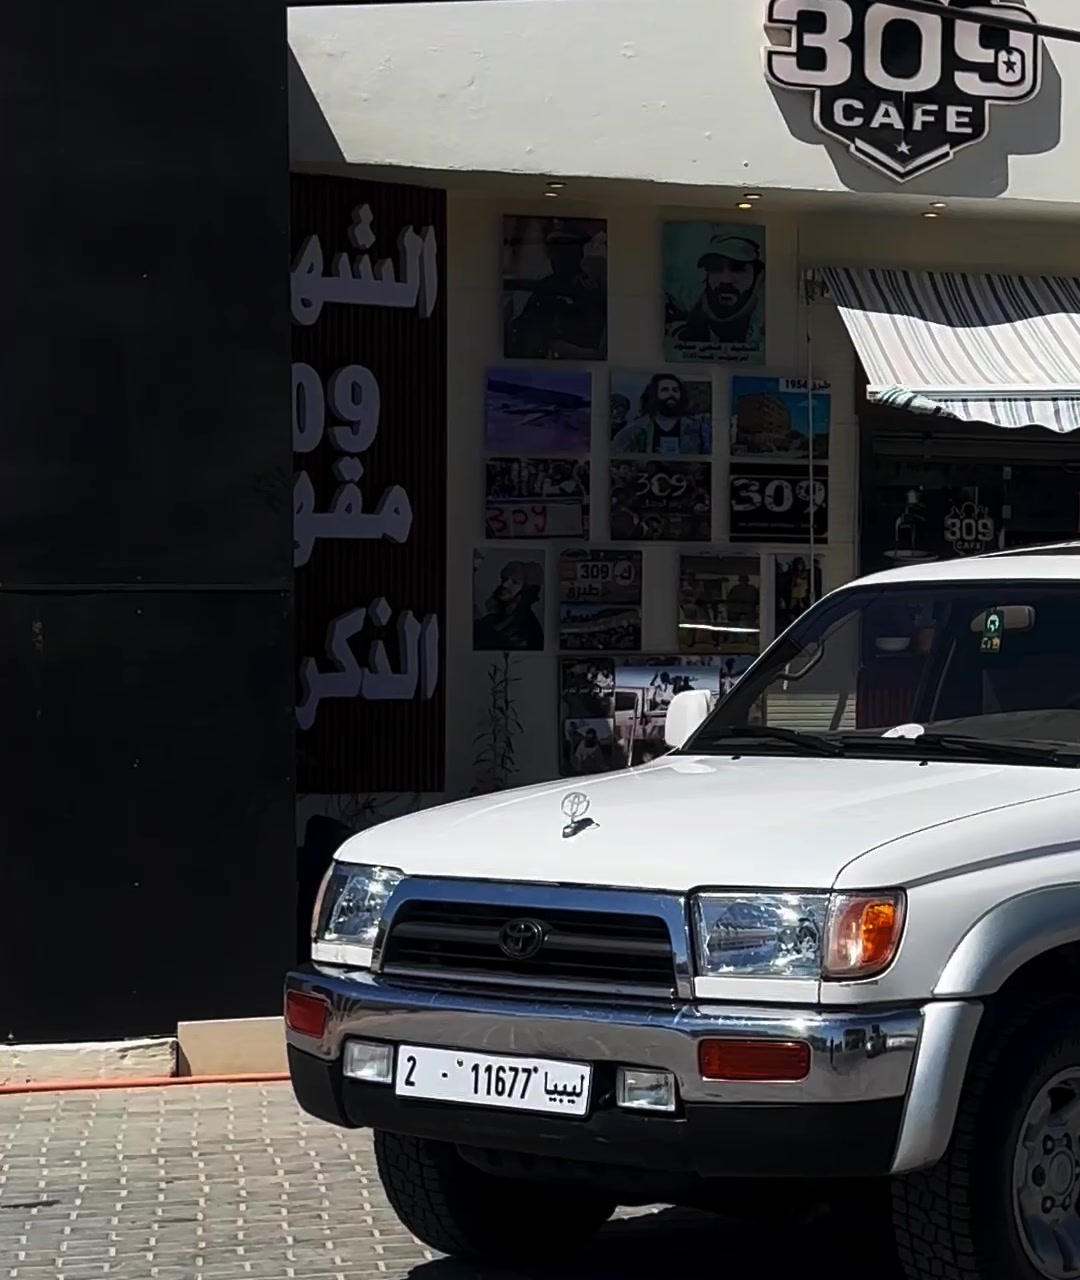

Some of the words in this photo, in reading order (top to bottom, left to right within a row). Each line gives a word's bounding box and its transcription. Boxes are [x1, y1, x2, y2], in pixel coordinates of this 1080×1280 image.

[832, 97, 974, 134] CAFE
[289, 203, 438, 326] الشه
[785, 378, 808, 390] 1954
[292, 361, 381, 454] 09
[293, 455, 414, 569] مقه
[731, 478, 827, 513] 309
[944, 517, 994, 542] 309
[580, 564, 610, 580] 309
[295, 596, 440, 731] الذكر
[405, 1055, 417, 1087] 2
[471, 1062, 532, 1100] 11677
[544, 1071, 585, 1104] ليبيا
